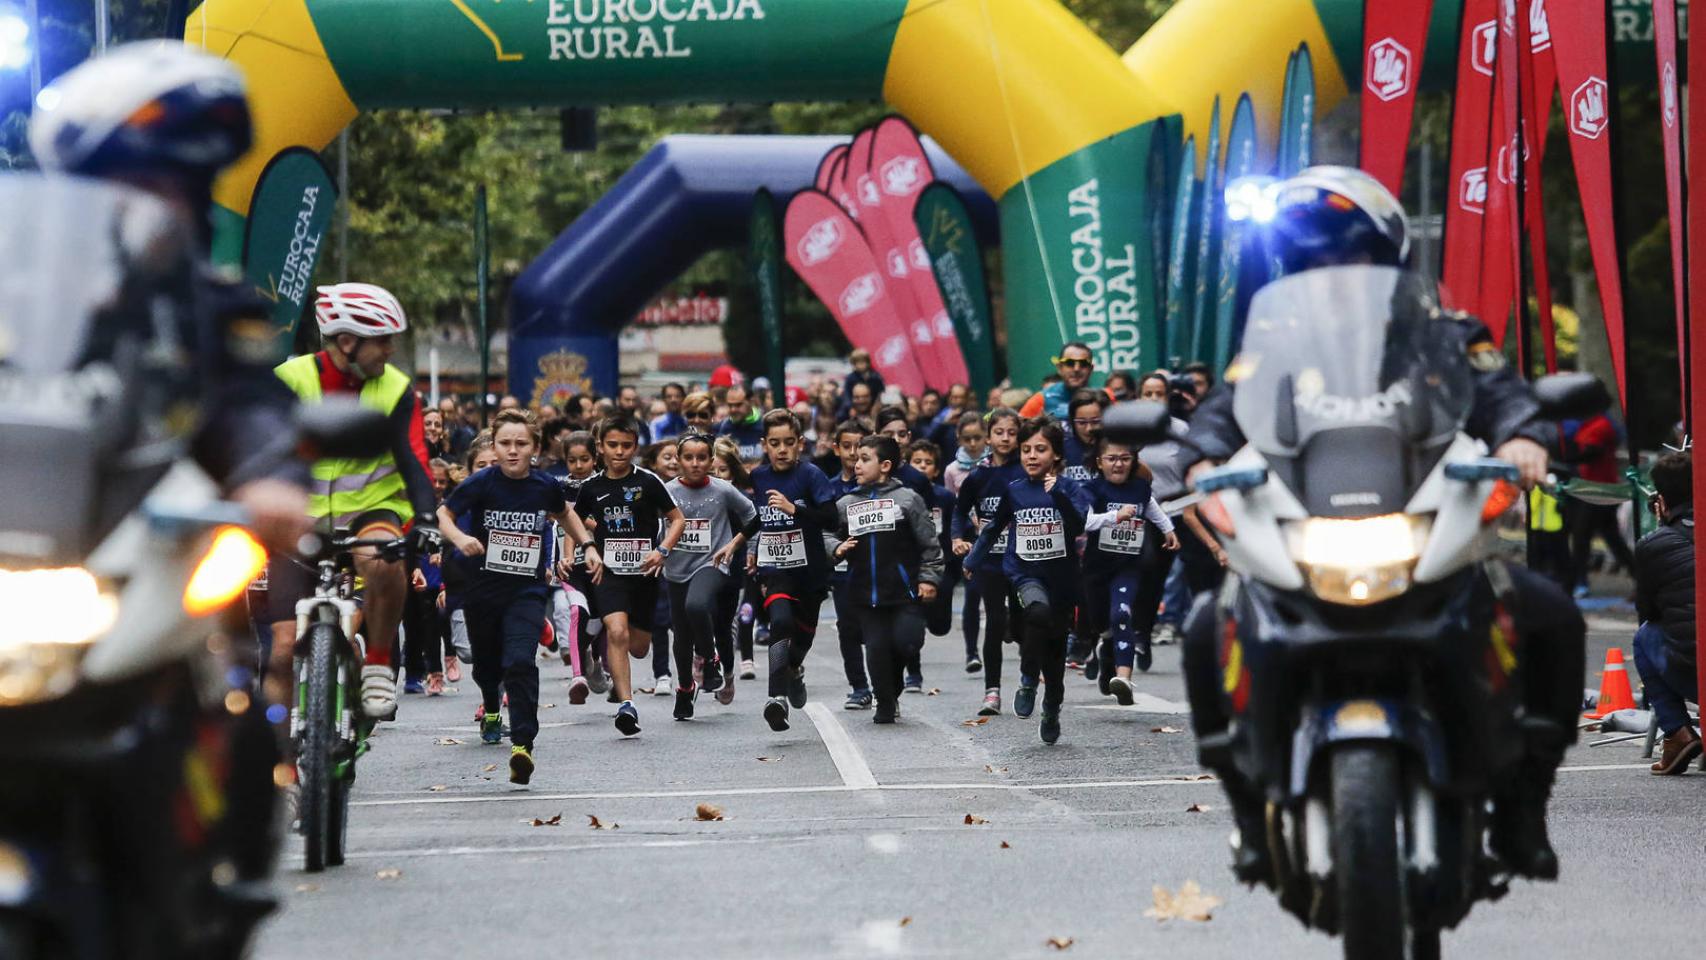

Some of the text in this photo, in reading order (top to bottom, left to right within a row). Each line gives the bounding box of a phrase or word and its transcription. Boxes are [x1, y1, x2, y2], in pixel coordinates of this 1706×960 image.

[546, 0, 766, 24] EUROCAJA
[547, 25, 691, 60] RURAL
[278, 186, 319, 299] EUROCAJA
[291, 232, 321, 307] RURAL
[1068, 178, 1110, 375] EUROCAJA
[1105, 244, 1141, 371] RURAL
[858, 511, 884, 525] 6026
[681, 532, 700, 544] 044
[1111, 529, 1137, 541] 6005
[767, 544, 793, 557] 6023
[1026, 538, 1053, 551] 8098
[501, 549, 530, 564] 6037
[615, 551, 641, 562] 6000
